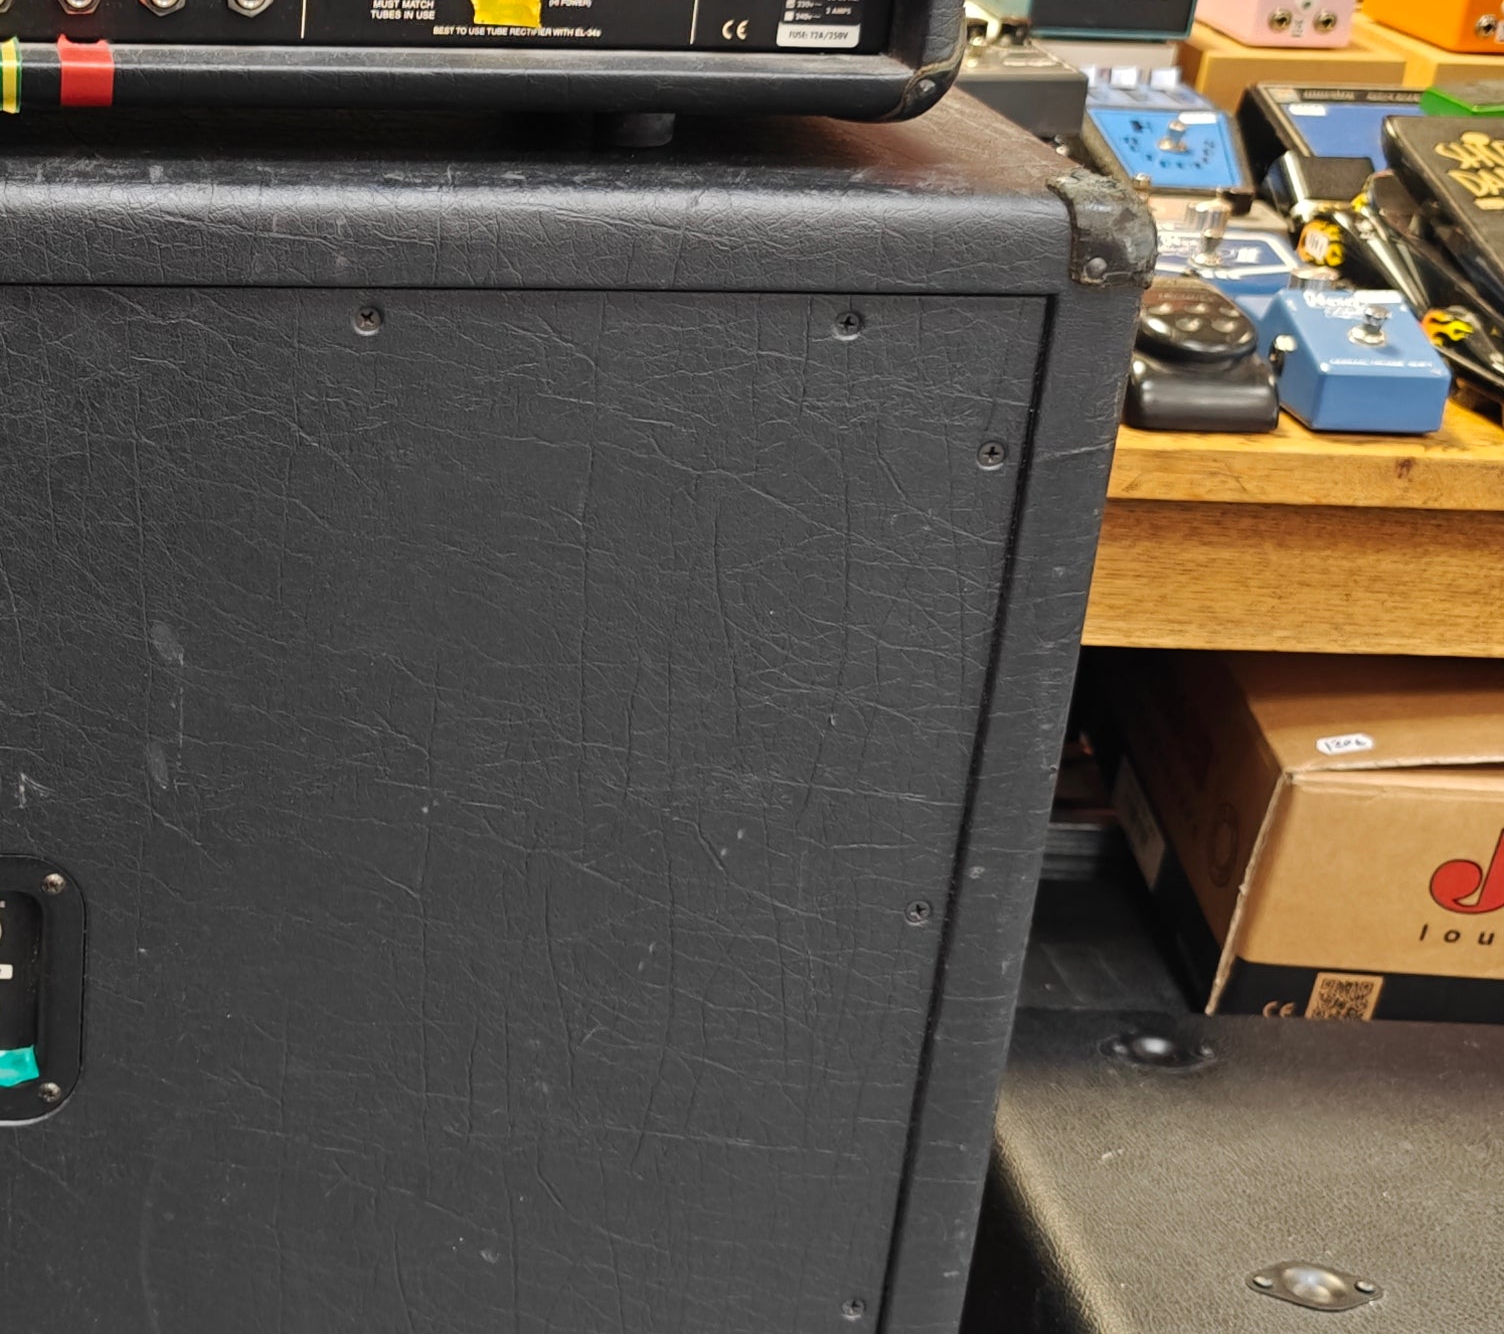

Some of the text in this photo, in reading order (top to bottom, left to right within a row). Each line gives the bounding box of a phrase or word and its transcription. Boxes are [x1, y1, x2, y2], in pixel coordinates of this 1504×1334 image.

[372, 0, 435, 9] MUST MATCH
[371, 10, 436, 20] TUBES IN USE
[433, 26, 454, 36] BEST
[455, 27, 468, 36] TO
[468, 26, 485, 36] USE
[486, 27, 508, 36] TUBE
[509, 27, 552, 37] RECTIFIER
[552, 27, 575, 37] WITH
[722, 19, 749, 40] CE
